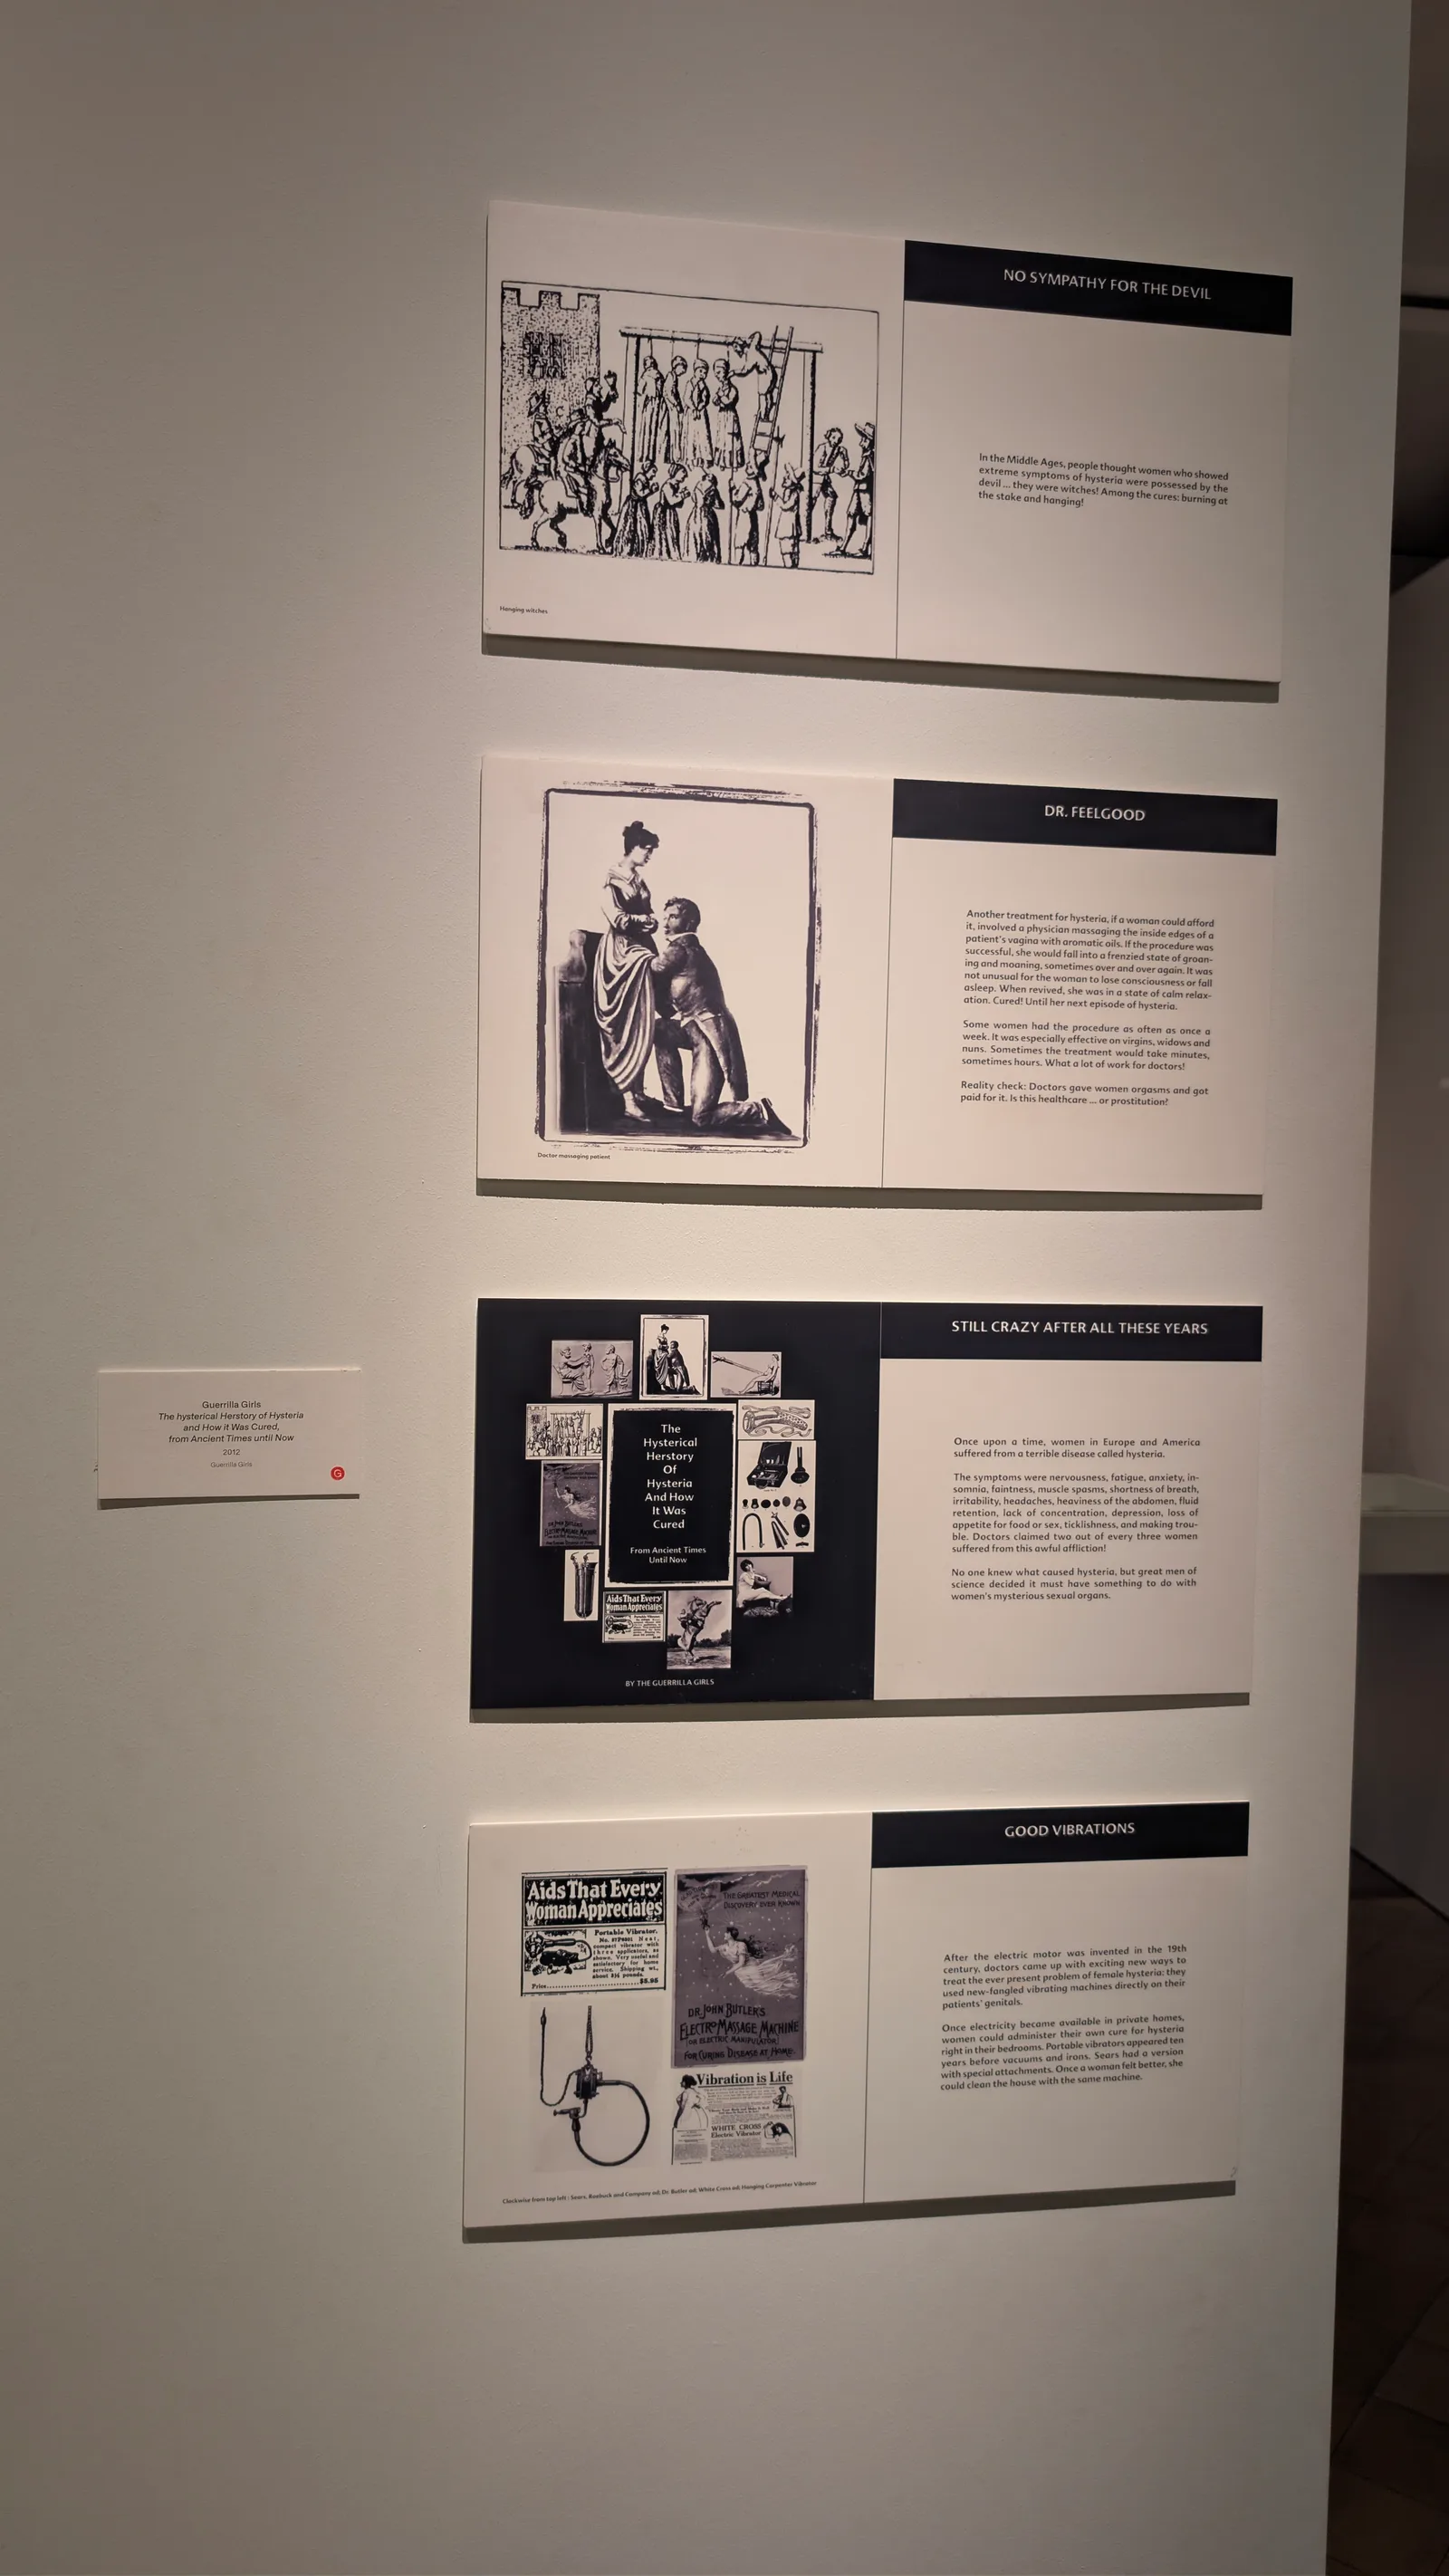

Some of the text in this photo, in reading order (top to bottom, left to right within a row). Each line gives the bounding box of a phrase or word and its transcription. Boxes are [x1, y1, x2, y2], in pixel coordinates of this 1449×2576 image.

[1003, 269, 1212, 300] NO SYMPATHY FOR THE DEVIL
[979, 453, 1229, 481] In the Middle Ages, people thought women who showed
[979, 466, 1229, 494] extreme symptoms of hysteria were possessed by the
[499, 605, 525, 614] Hanging
[1045, 804, 1146, 822] DR. FEELGOOD
[966, 909, 1005, 919] Another
[1006, 912, 1053, 921] treatment
[1055, 912, 1069, 922] for
[1070, 913, 1109, 924] hysteria,
[1110, 915, 1118, 924] if
[1126, 918, 1160, 926] woman
[1161, 918, 1185, 927] could
[1186, 918, 1214, 928] afford
[558, 1153, 590, 1161] massaging
[952, 1321, 1208, 1334] STILL CRAZY AFTER ALL THESE YEARS
[202, 1400, 262, 1409] Guerrilla Girls
[158, 1411, 304, 1422] The hysterical Herstory of Hysteria
[183, 1424, 201, 1432] and
[223, 1423, 230, 1431] it
[231, 1423, 249, 1431] Was
[251, 1422, 280, 1432] Cured,
[660, 1424, 681, 1434] The
[168, 1434, 295, 1443] from Ancient Times until Now
[643, 1437, 697, 1449] Hysterical
[954, 1437, 979, 1446] Once
[983, 1439, 1007, 1447] upon
[1022, 1437, 1046, 1447] time,
[1089, 1437, 1099, 1446] in
[1103, 1437, 1136, 1448] Europe
[1139, 1437, 1157, 1447] and
[1162, 1437, 1201, 1447] America
[647, 1451, 694, 1463] Herstory
[333, 1469, 342, 1478] G
[663, 1464, 677, 1475] Of
[647, 1478, 693, 1490] Hysteria
[645, 1492, 695, 1502] And How
[652, 1505, 686, 1515] It Was
[653, 1519, 685, 1529] Cured
[630, 1546, 650, 1554] From
[651, 1546, 682, 1554] Ancient
[607, 1594, 662, 1602] Aids That Every
[606, 1603, 662, 1611] Woman Appreciates
[1004, 1822, 1136, 1838] GOOD VIBRATIONS
[528, 1879, 566, 1900] Aids
[567, 1879, 608, 1898] That
[610, 1879, 661, 1898] Every
[525, 1898, 663, 1922] Woman Appreciates
[594, 1928, 624, 1937] Portable
[944, 1953, 969, 1962] After
[974, 1952, 989, 1961] the
[993, 1951, 1028, 1960] electric
[1032, 1950, 1062, 1958] motor
[1089, 1946, 1129, 1956] invented
[1134, 1946, 1143, 1955] in
[1147, 1946, 1163, 1954] the
[1167, 1944, 1187, 1953] 19th
[696, 2071, 793, 2086] Vibration is Life
[711, 2124, 736, 2132] WHITE
